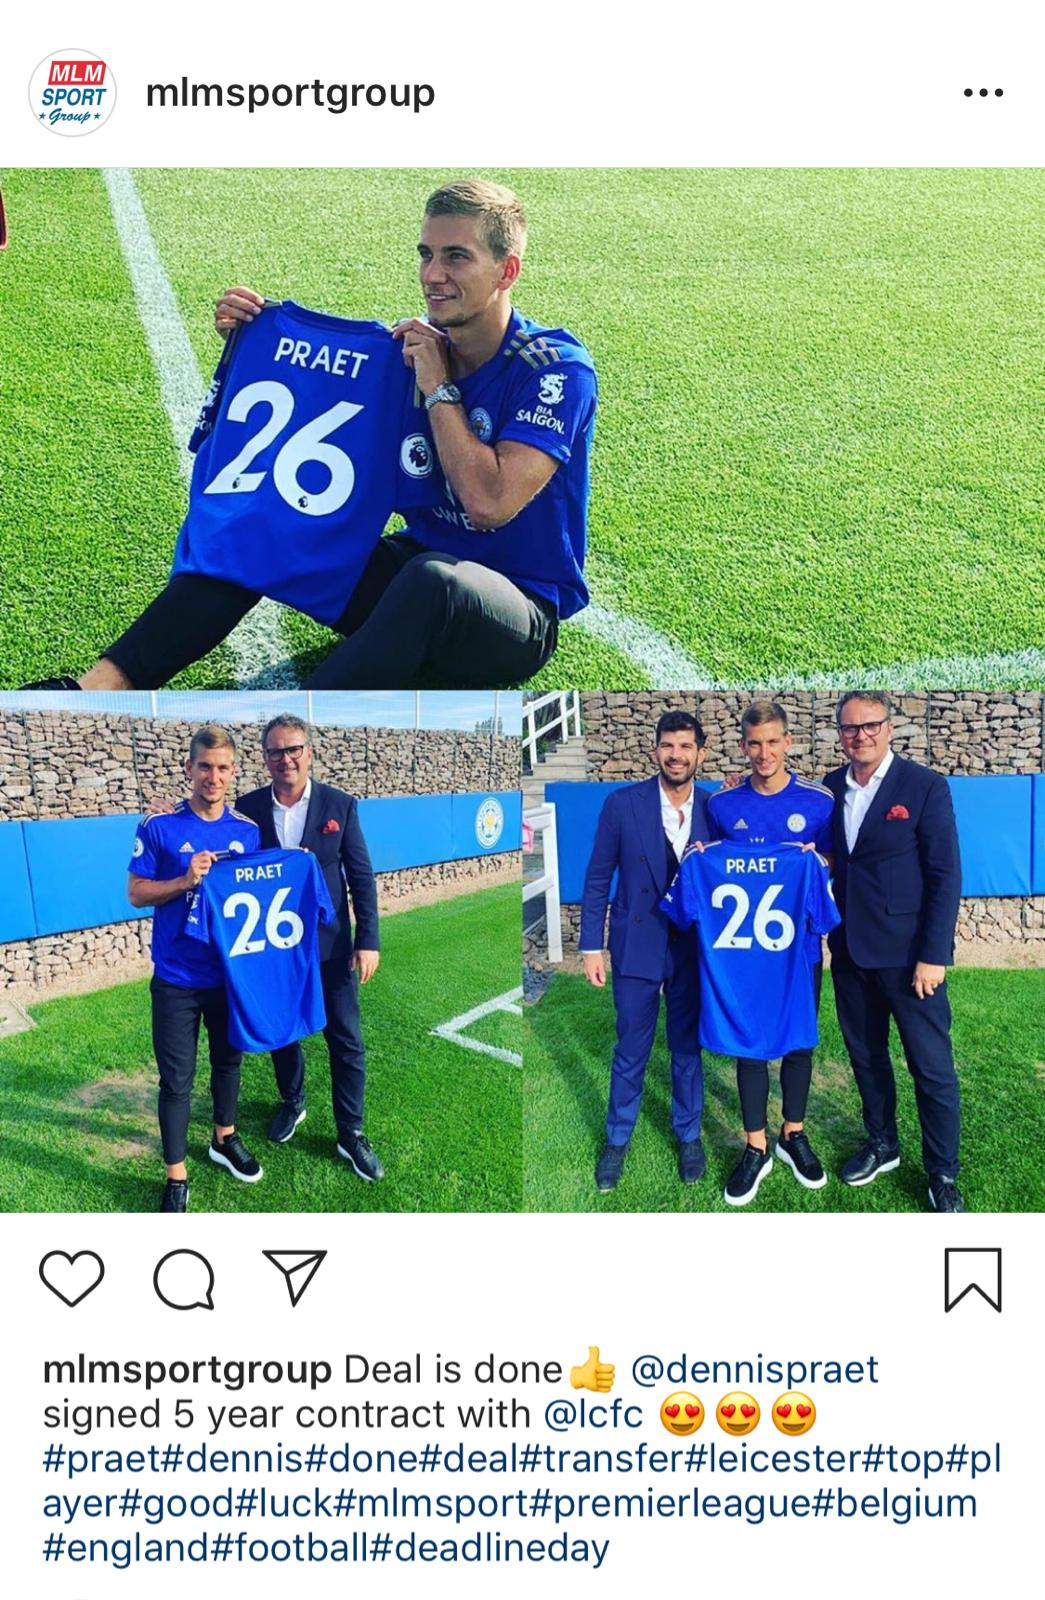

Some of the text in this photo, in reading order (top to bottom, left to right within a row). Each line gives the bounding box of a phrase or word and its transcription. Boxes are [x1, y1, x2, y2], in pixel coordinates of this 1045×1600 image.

[273, 337, 370, 379] PRAET
[202, 380, 365, 516] 26
[235, 863, 283, 884] PRAET
[725, 857, 778, 874] PRAET
[223, 887, 305, 958] 26
[711, 883, 796, 952] 26
